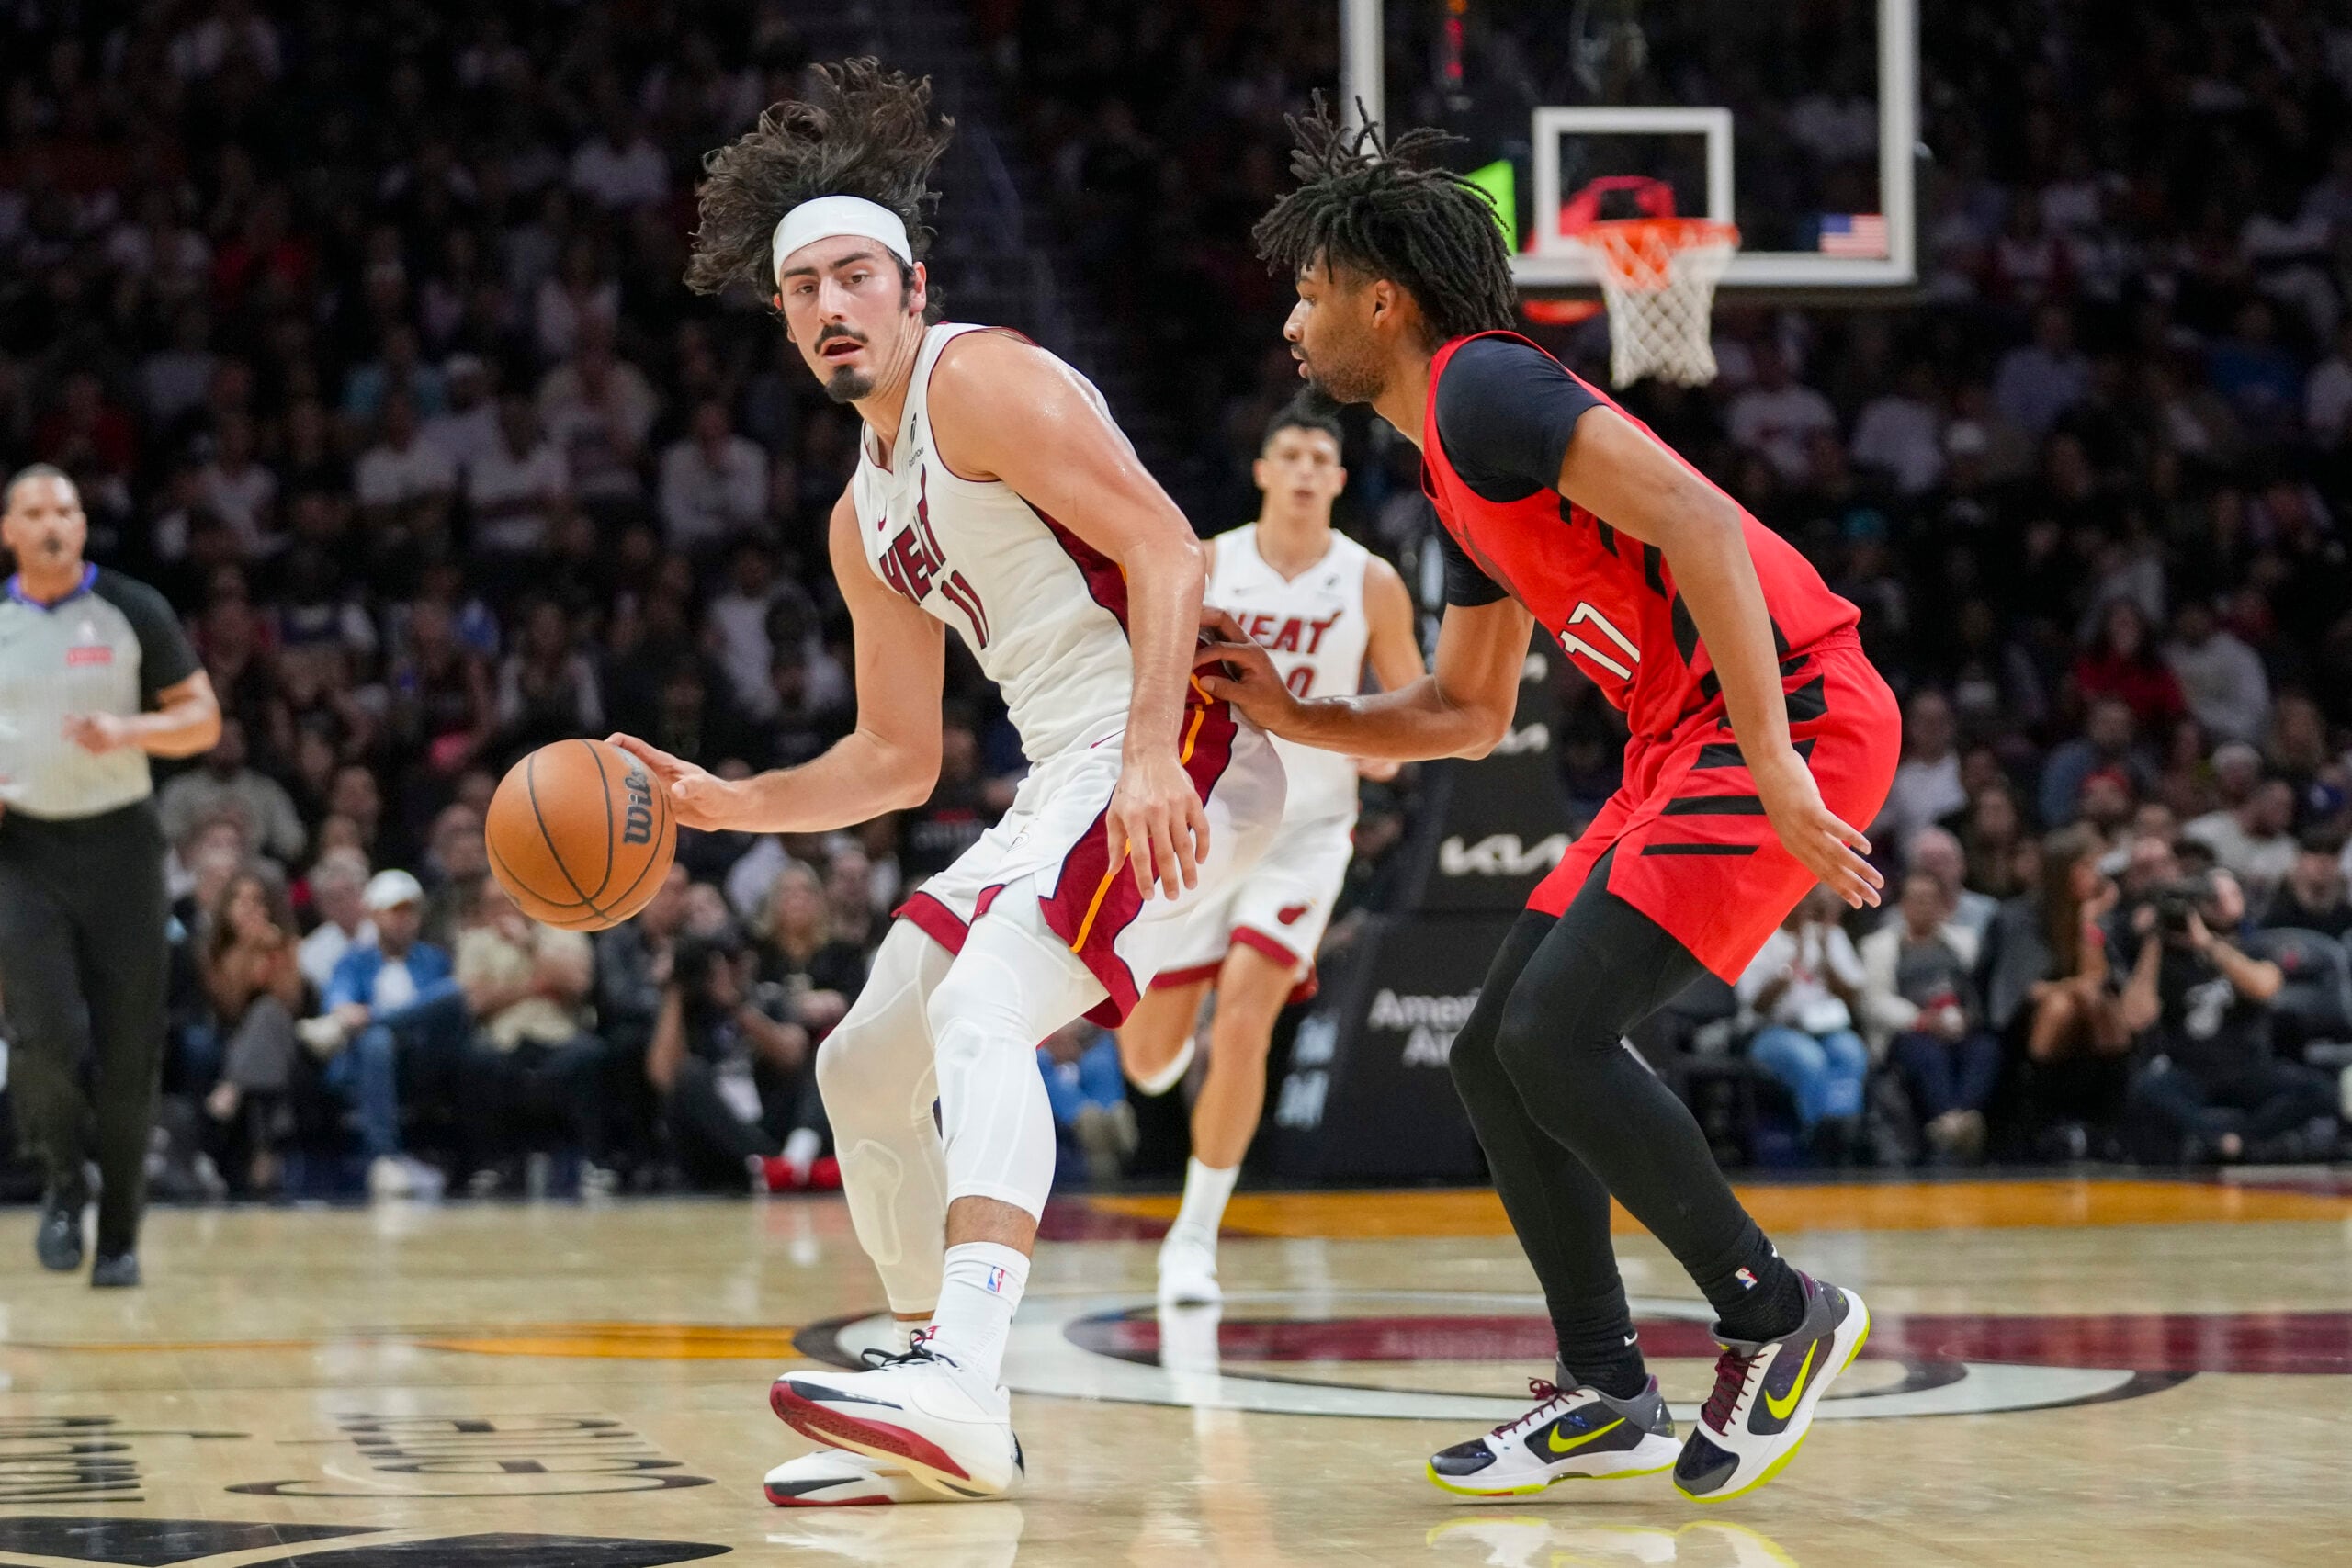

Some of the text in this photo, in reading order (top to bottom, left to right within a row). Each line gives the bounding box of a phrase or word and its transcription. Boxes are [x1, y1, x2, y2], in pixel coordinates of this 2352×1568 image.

[940, 569, 989, 650] 11
[1237, 608, 1342, 655] EAT
[1560, 599, 1641, 682] 17
[224, 1412, 717, 1498] Center
